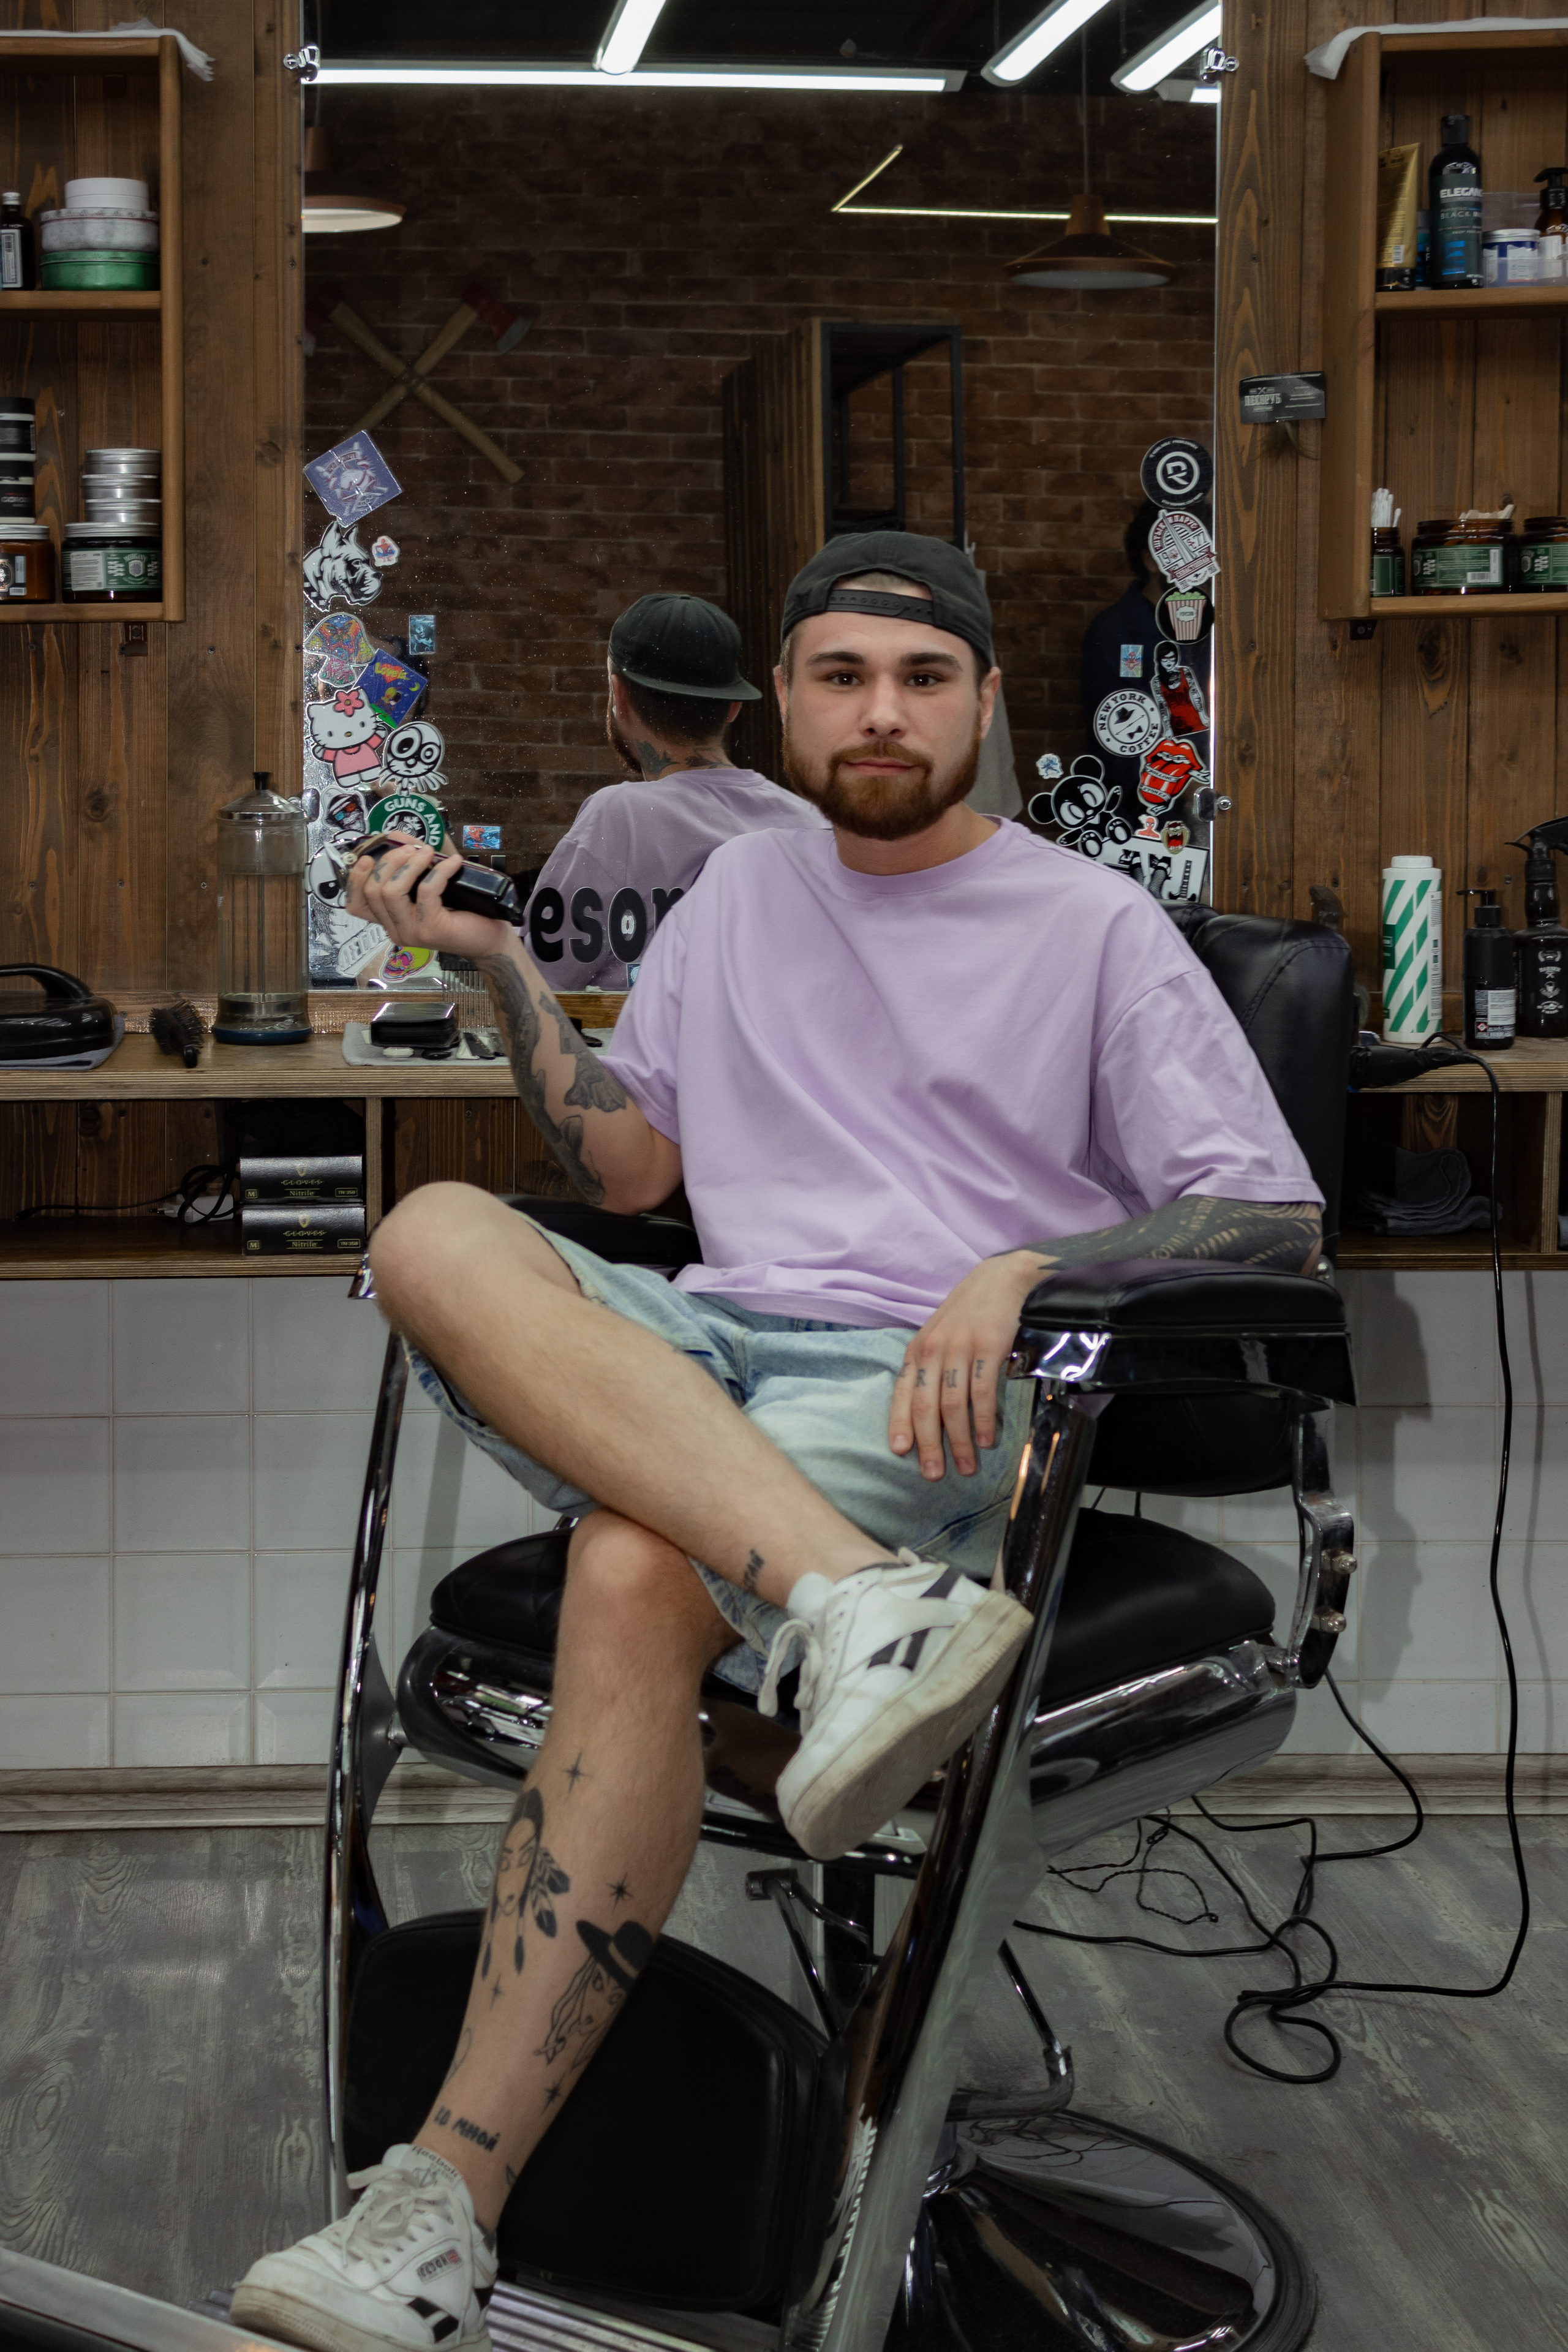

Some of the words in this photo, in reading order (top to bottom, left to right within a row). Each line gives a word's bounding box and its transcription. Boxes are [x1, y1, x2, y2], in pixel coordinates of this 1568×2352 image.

[1099, 703, 1112, 731] NEW
[1111, 693, 1146, 705] YORK
[1120, 723, 1159, 753] COFFEE
[384, 797, 427, 812] GUNS
[423, 813, 442, 846] AND
